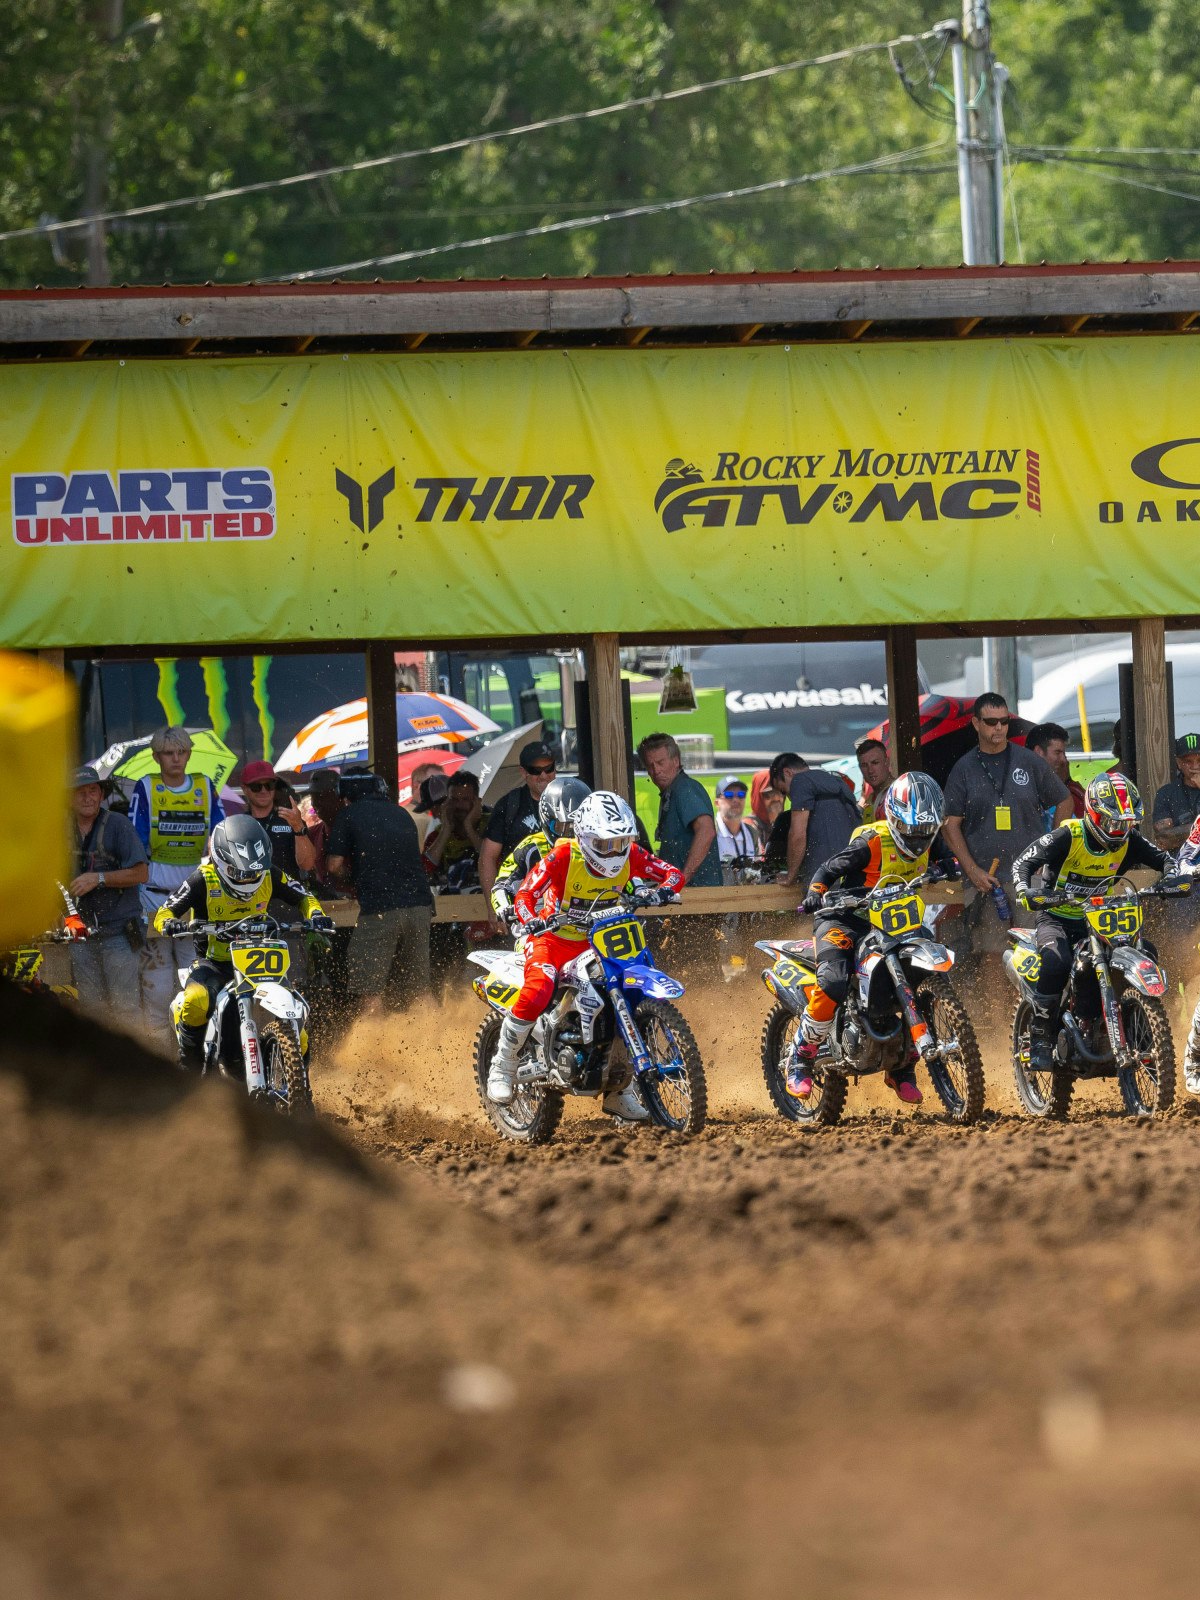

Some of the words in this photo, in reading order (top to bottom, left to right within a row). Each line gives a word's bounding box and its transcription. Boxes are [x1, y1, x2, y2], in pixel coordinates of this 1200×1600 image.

[711, 452, 826, 482] ROCKY
[829, 448, 1021, 478] MOUNTAIN
[13, 469, 274, 515] PARTS
[413, 474, 595, 522] THOR
[661, 483, 839, 534] ATV
[848, 479, 1022, 524] MC
[15, 511, 275, 544] UNLIMITED
[881, 899, 921, 933] 61
[1098, 908, 1138, 936] 95
[602, 923, 643, 959] 81
[245, 950, 284, 975] 20
[775, 963, 808, 988] 61
[486, 979, 519, 1005] 81
[247, 1037, 262, 1075] PIRELLI
